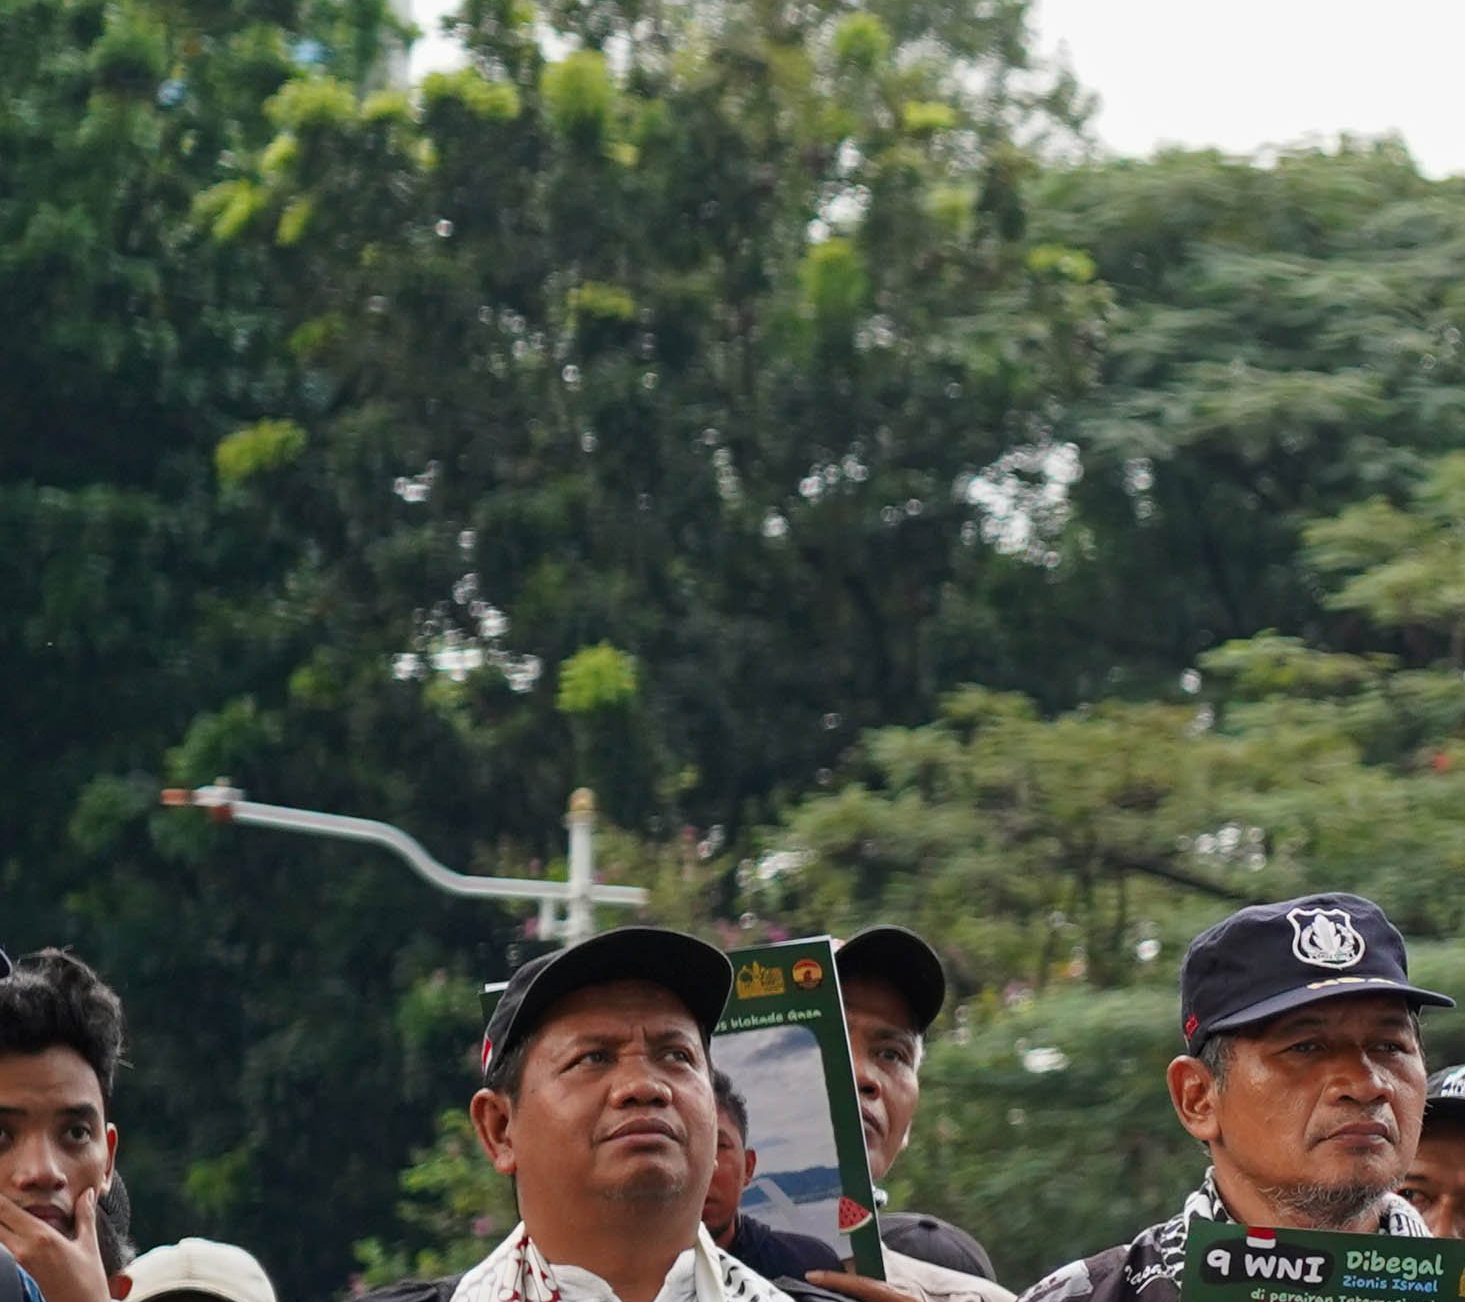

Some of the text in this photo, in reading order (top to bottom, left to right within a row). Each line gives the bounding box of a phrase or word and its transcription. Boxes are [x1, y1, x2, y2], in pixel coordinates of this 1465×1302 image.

[731, 1011, 784, 1028] blokade
[788, 1008, 821, 1022] Gaza
[1206, 1249, 1231, 1276] 9
[1244, 1252, 1325, 1284] WNI
[1346, 1250, 1444, 1281] Dibegal
[1343, 1275, 1438, 1293] Zionis Israel
[1250, 1288, 1265, 1301] di
